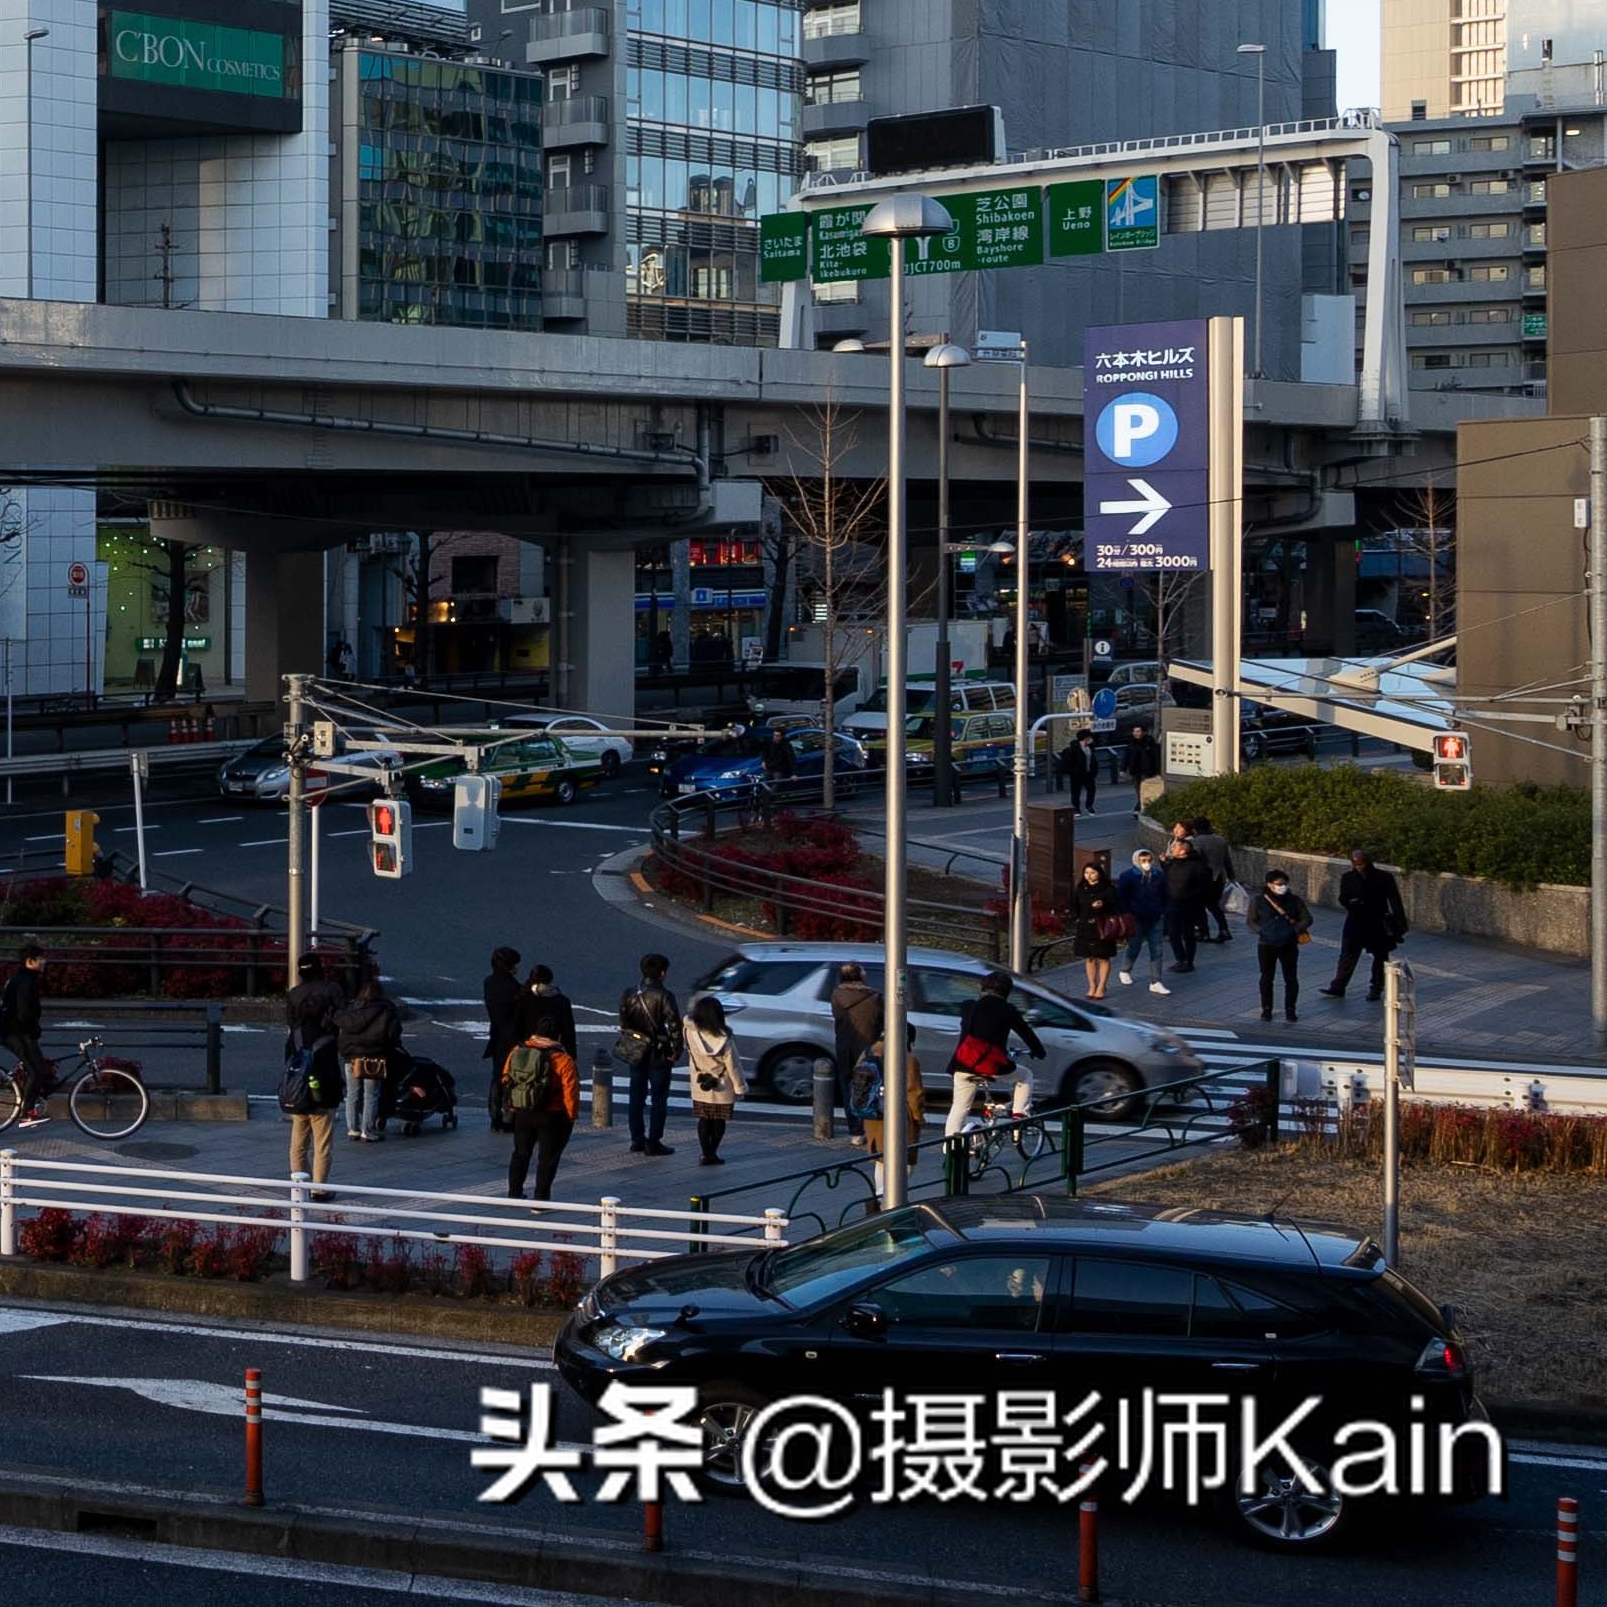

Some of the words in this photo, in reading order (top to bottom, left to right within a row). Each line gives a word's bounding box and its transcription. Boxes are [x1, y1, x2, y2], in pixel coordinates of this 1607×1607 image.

[206, 57, 281, 82] COSMETICS
[975, 193, 1028, 213] 芝公園
[975, 211, 1035, 227] Shibakoen
[1062, 206, 1092, 221] 上野
[1062, 221, 1091, 231] Ueno
[976, 225, 1029, 244] 湾岸線
[764, 237, 803, 250] さいたま
[819, 243, 868, 259] 北池袋
[976, 242, 1024, 256] Bayshore
[763, 249, 802, 259] Saitama
[1095, 346, 1195, 369] 六本木ヒルズ
[1096, 370, 1158, 384] ROPPONGI
[1160, 368, 1194, 380] HILLS
[1114, 403, 1160, 458] P
